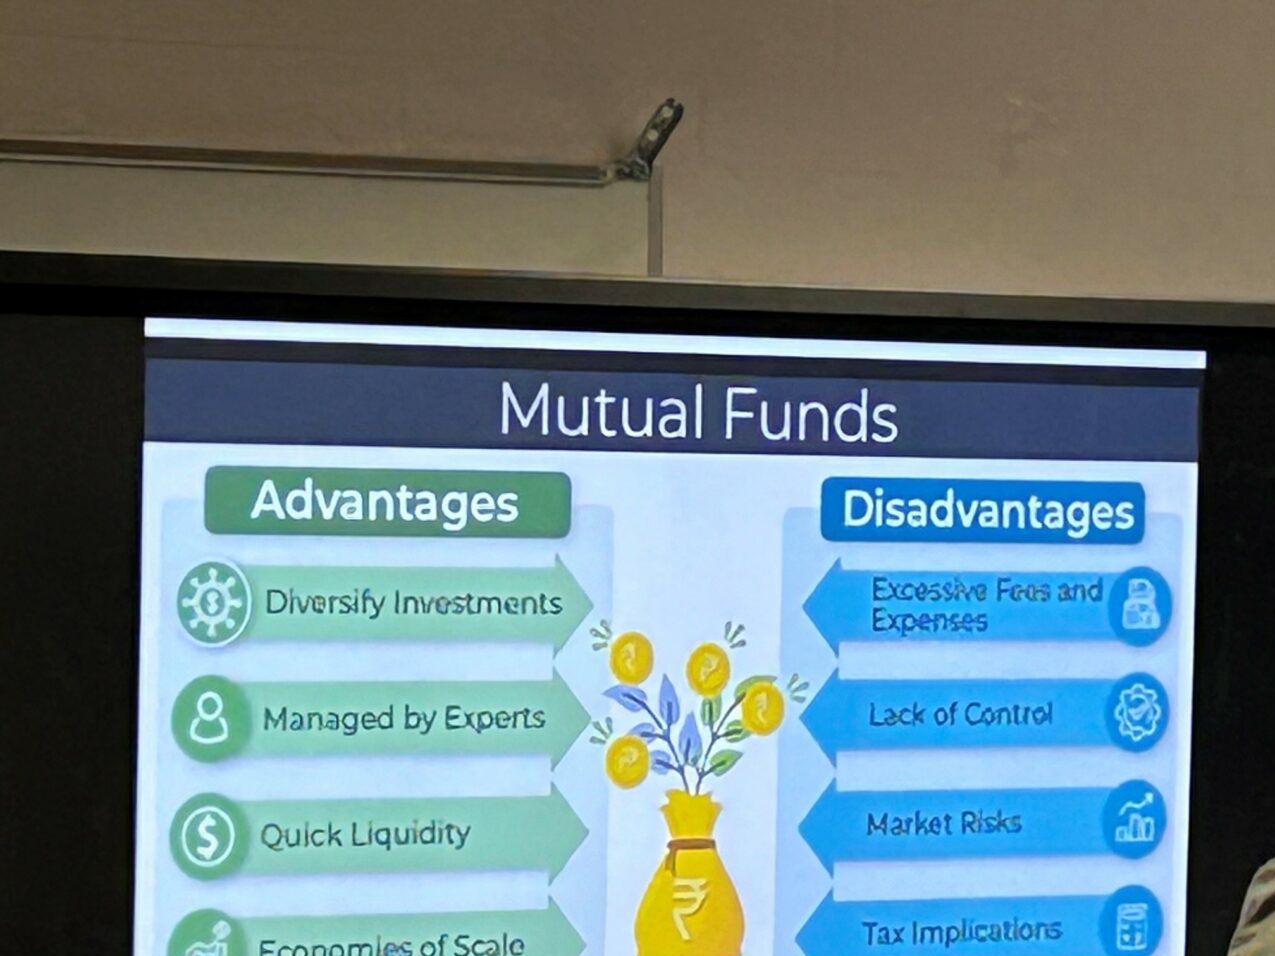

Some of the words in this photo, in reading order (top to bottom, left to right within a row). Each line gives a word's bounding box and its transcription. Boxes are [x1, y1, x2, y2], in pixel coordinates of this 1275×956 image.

[501, 381, 703, 440] Mutual
[724, 386, 900, 444] Funds
[250, 477, 520, 531] Advantages
[843, 487, 1136, 538] Disadvantages
[265, 587, 387, 621] Diversify
[394, 589, 563, 616] Investments
[872, 576, 987, 602] Excessive
[996, 577, 1050, 602] Fees
[1057, 577, 1104, 603] and
[872, 607, 989, 637] Expenses
[262, 705, 394, 736] Managed
[404, 704, 434, 735] by
[445, 705, 546, 735] Experts
[869, 702, 925, 727] Lack
[933, 702, 959, 726] of
[964, 702, 1054, 726] Control
[260, 820, 343, 852] Quick
[351, 818, 471, 851] Liquidity
[866, 810, 953, 836] Market
[961, 809, 1023, 834] Risks
[861, 919, 905, 946] Tax
[911, 918, 1064, 951] Implications
